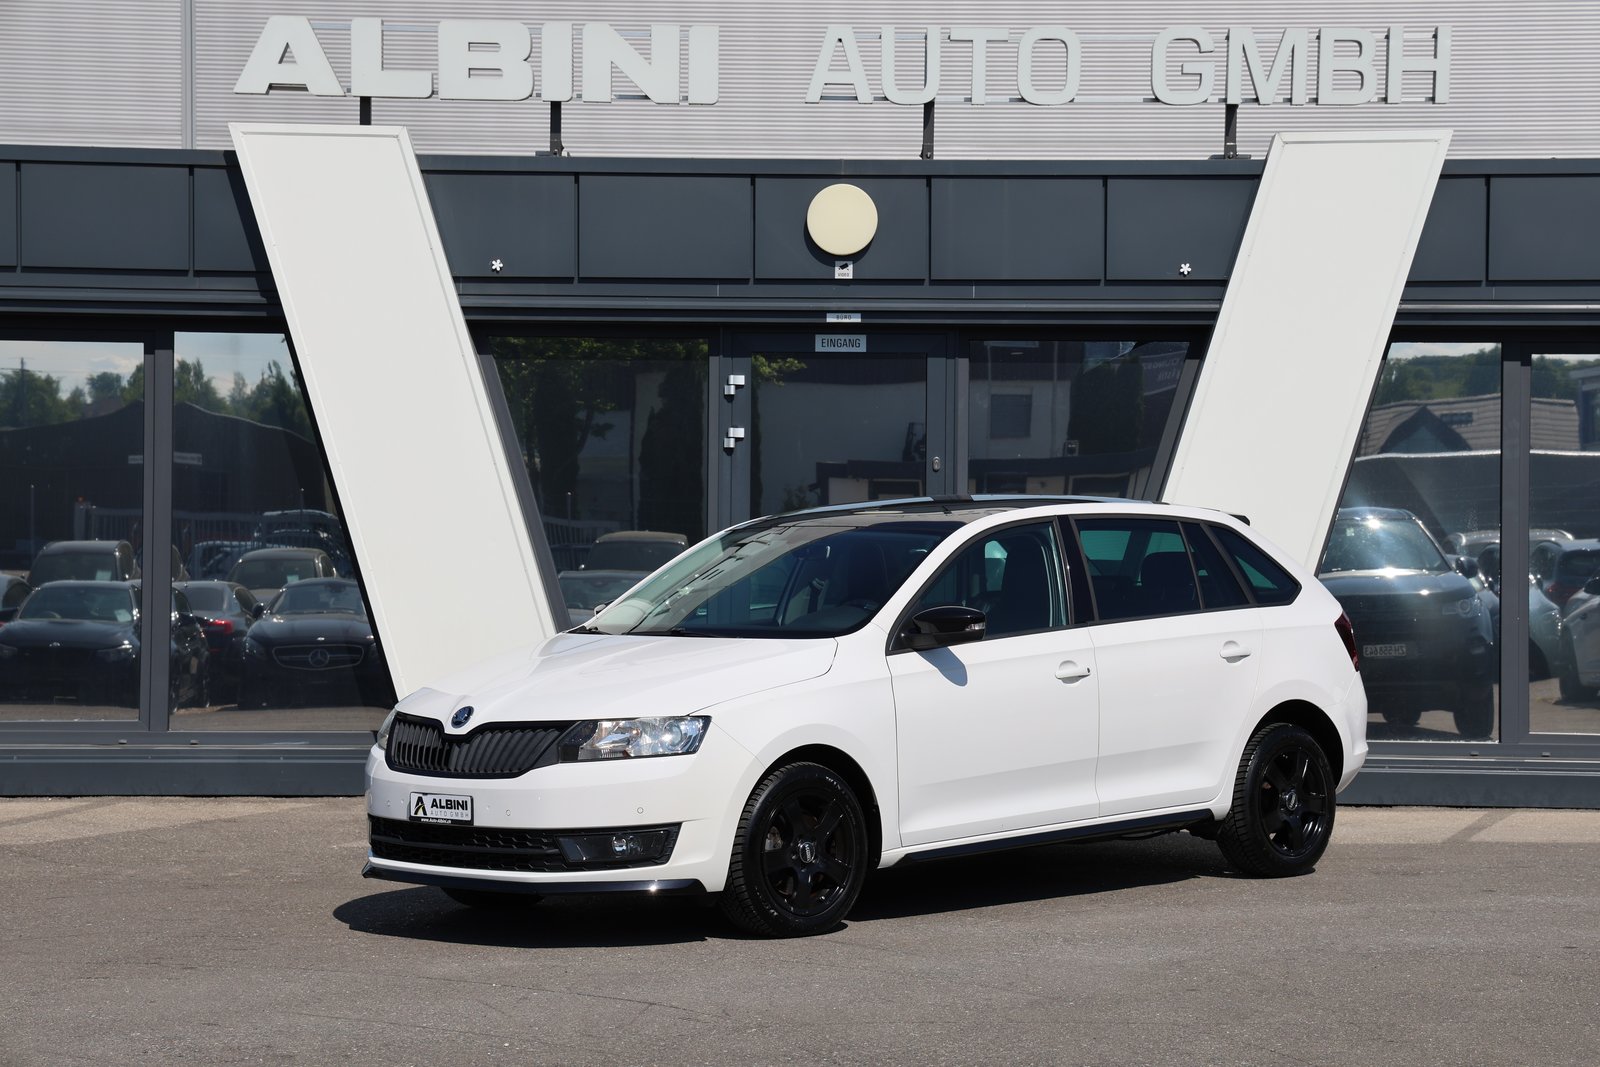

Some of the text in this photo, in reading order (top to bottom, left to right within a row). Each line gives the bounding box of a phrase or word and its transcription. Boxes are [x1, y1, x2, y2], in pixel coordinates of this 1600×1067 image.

[233, 15, 1452, 106] ALBINI AUTO GMBH
[821, 338, 861, 348] EINGANG
[431, 798, 468, 811] ALBINI
